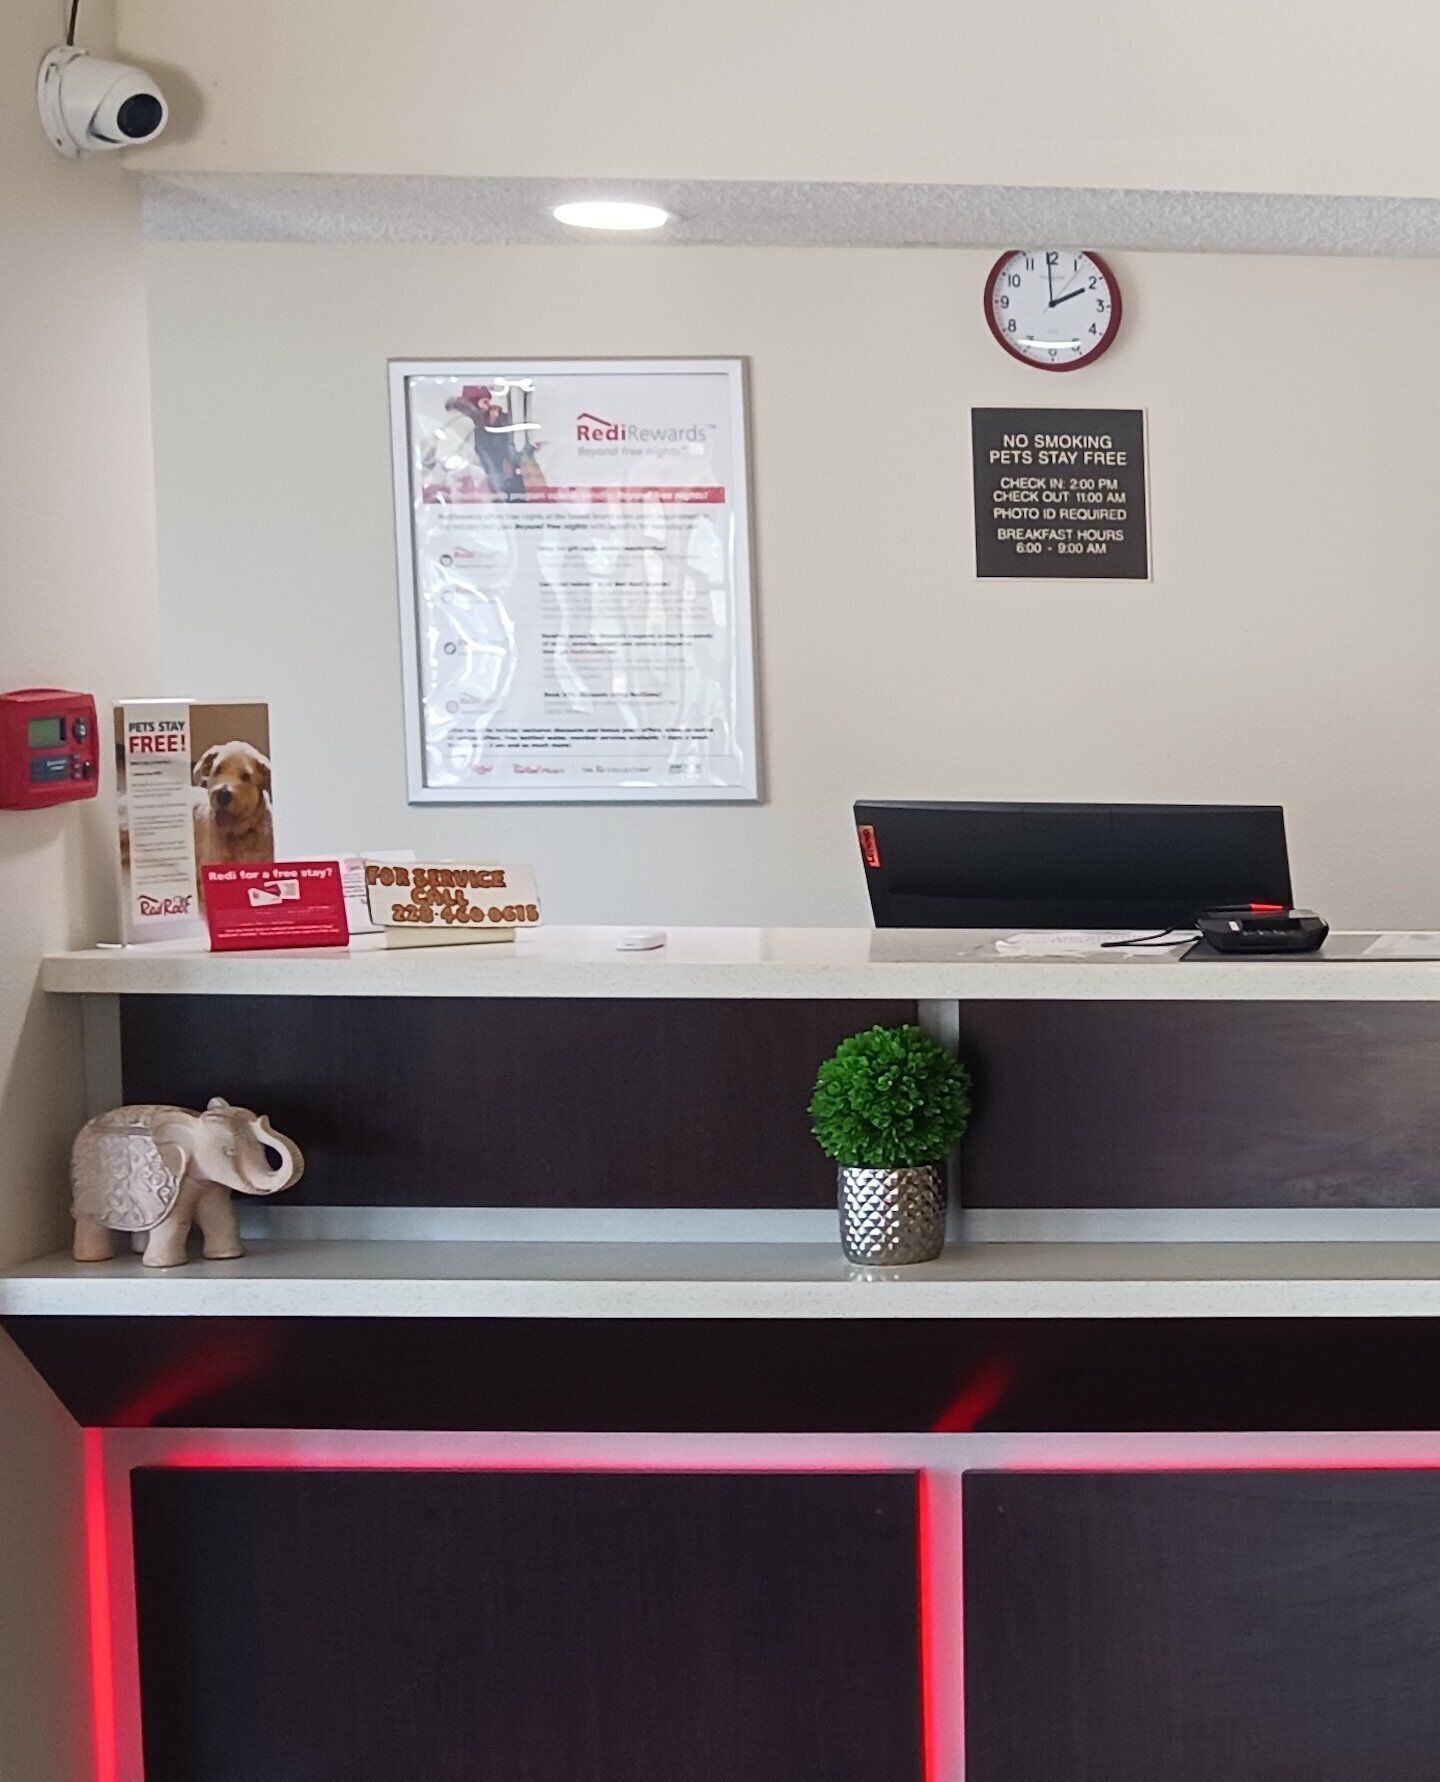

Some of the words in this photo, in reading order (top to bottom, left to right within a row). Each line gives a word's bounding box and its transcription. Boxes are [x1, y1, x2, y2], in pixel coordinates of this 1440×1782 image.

[1008, 275, 1021, 288] 10
[1088, 276, 1098, 290] 2
[1000, 296, 1010, 309] 9
[1096, 299, 1105, 313] 3
[1007, 319, 1017, 333] 8
[1088, 323, 1097, 336] 4
[1003, 434, 1029, 448] NO
[1034, 435, 1113, 449] SMOKING
[989, 450, 1033, 464] PETS
[1038, 451, 1078, 465] STAY
[1084, 452, 1128, 466] FREE
[1000, 477, 1046, 490] CHECK
[1098, 479, 1118, 491] PM
[993, 490, 1039, 503] CHECK
[1106, 492, 1126, 504] AM
[993, 507, 1040, 520] PHOTO
[1043, 508, 1057, 520] ID
[1059, 508, 1127, 521] REQUIRED
[997, 528, 1073, 541] BREAKFAST
[1077, 529, 1124, 541] HOURS
[1086, 543, 1107, 554] AM
[128, 722, 155, 732] PETS
[158, 721, 186, 732] STAY
[129, 734, 186, 754] FREE!
[367, 865, 410, 887] FOR
[412, 868, 507, 888] SERVICE
[410, 887, 470, 907] CALL
